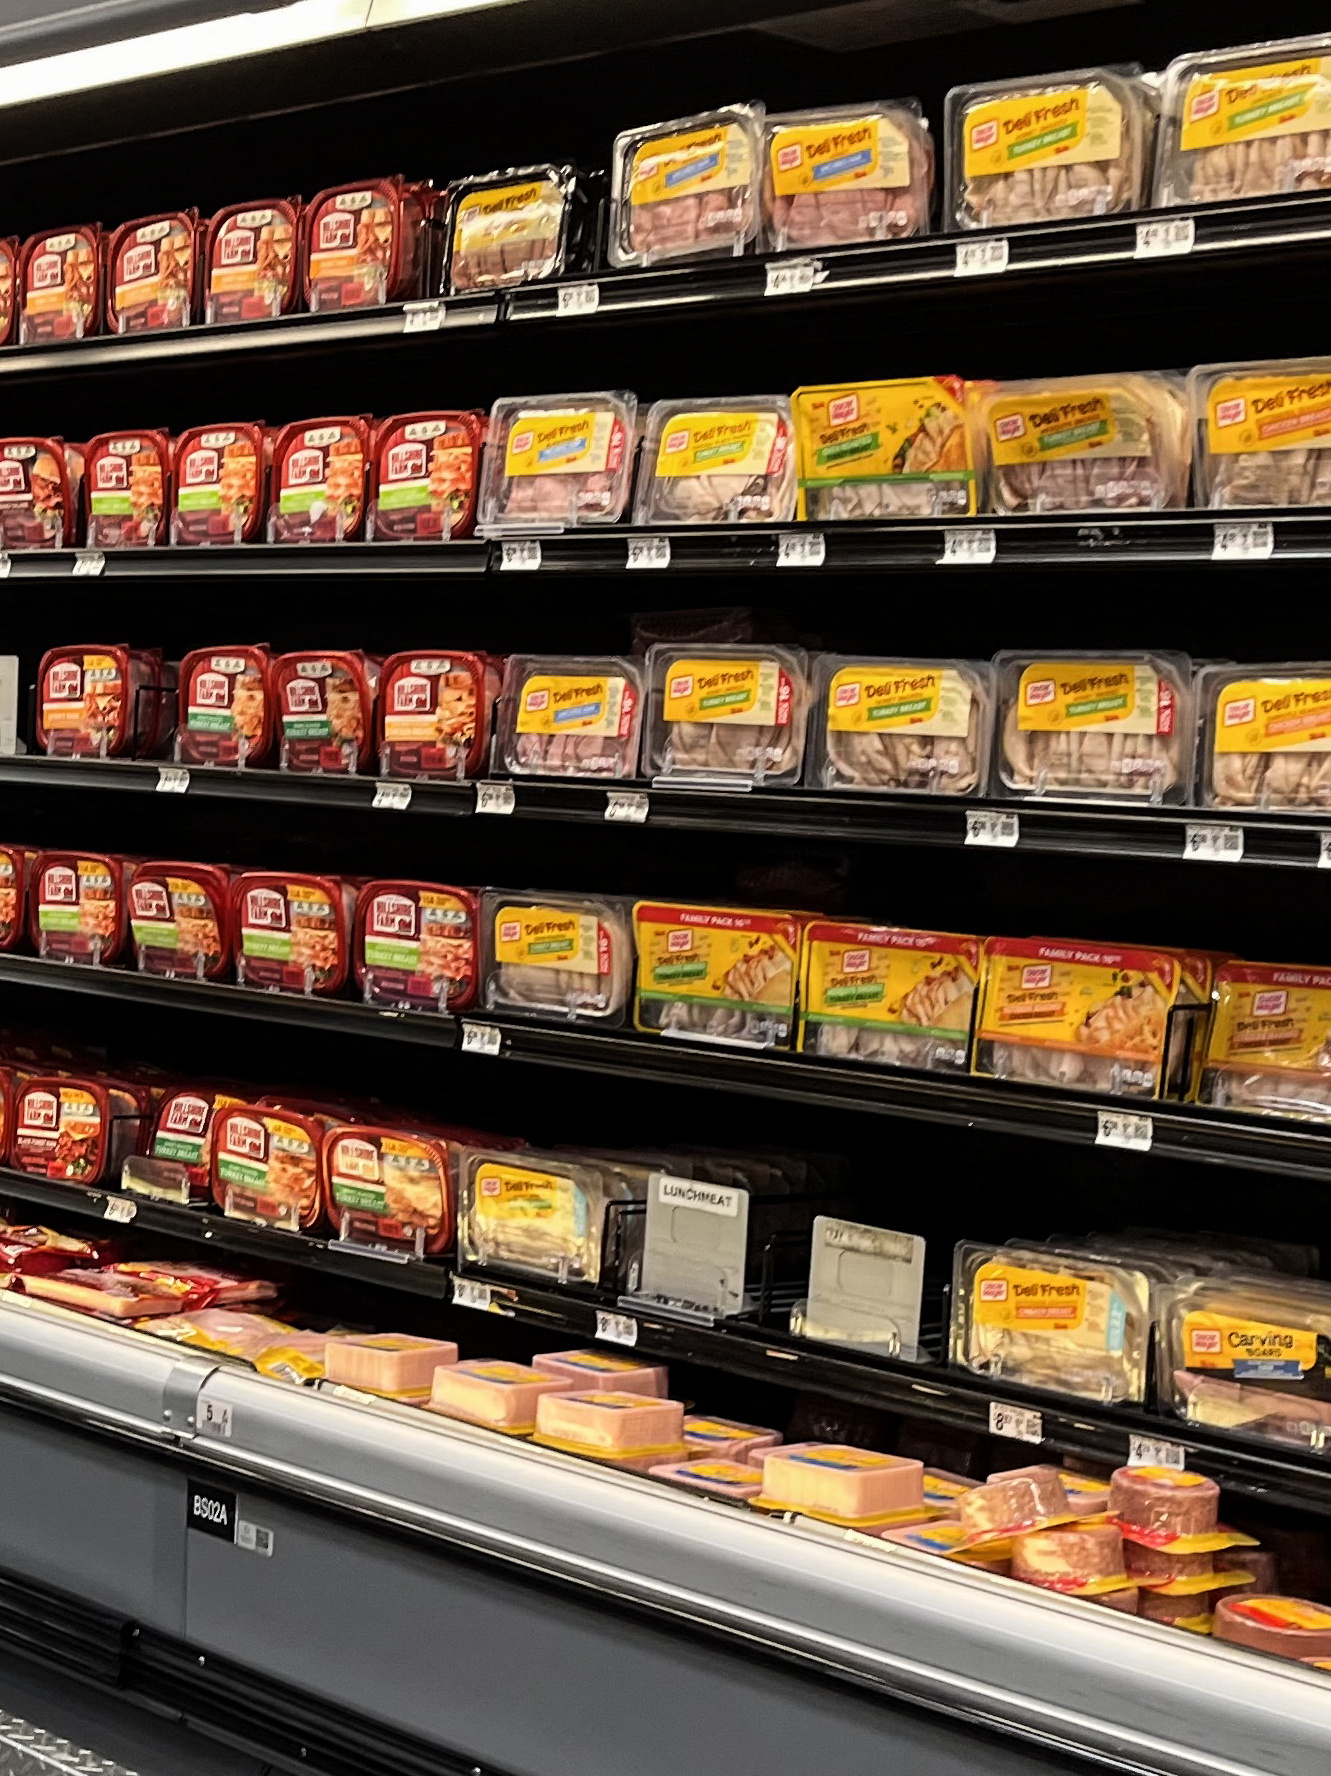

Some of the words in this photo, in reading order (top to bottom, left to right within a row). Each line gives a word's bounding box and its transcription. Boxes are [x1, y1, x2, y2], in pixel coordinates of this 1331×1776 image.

[1286, 380, 1331, 405] Fres
[1312, 974, 1331, 986] PAC
[662, 1183, 734, 1207] LUNCHMEAT
[1013, 1284, 1038, 1296] Deli
[1041, 1283, 1080, 1296] Fresh
[1228, 1331, 1294, 1349] Carving
[193, 1494, 228, 1526] BS02A
